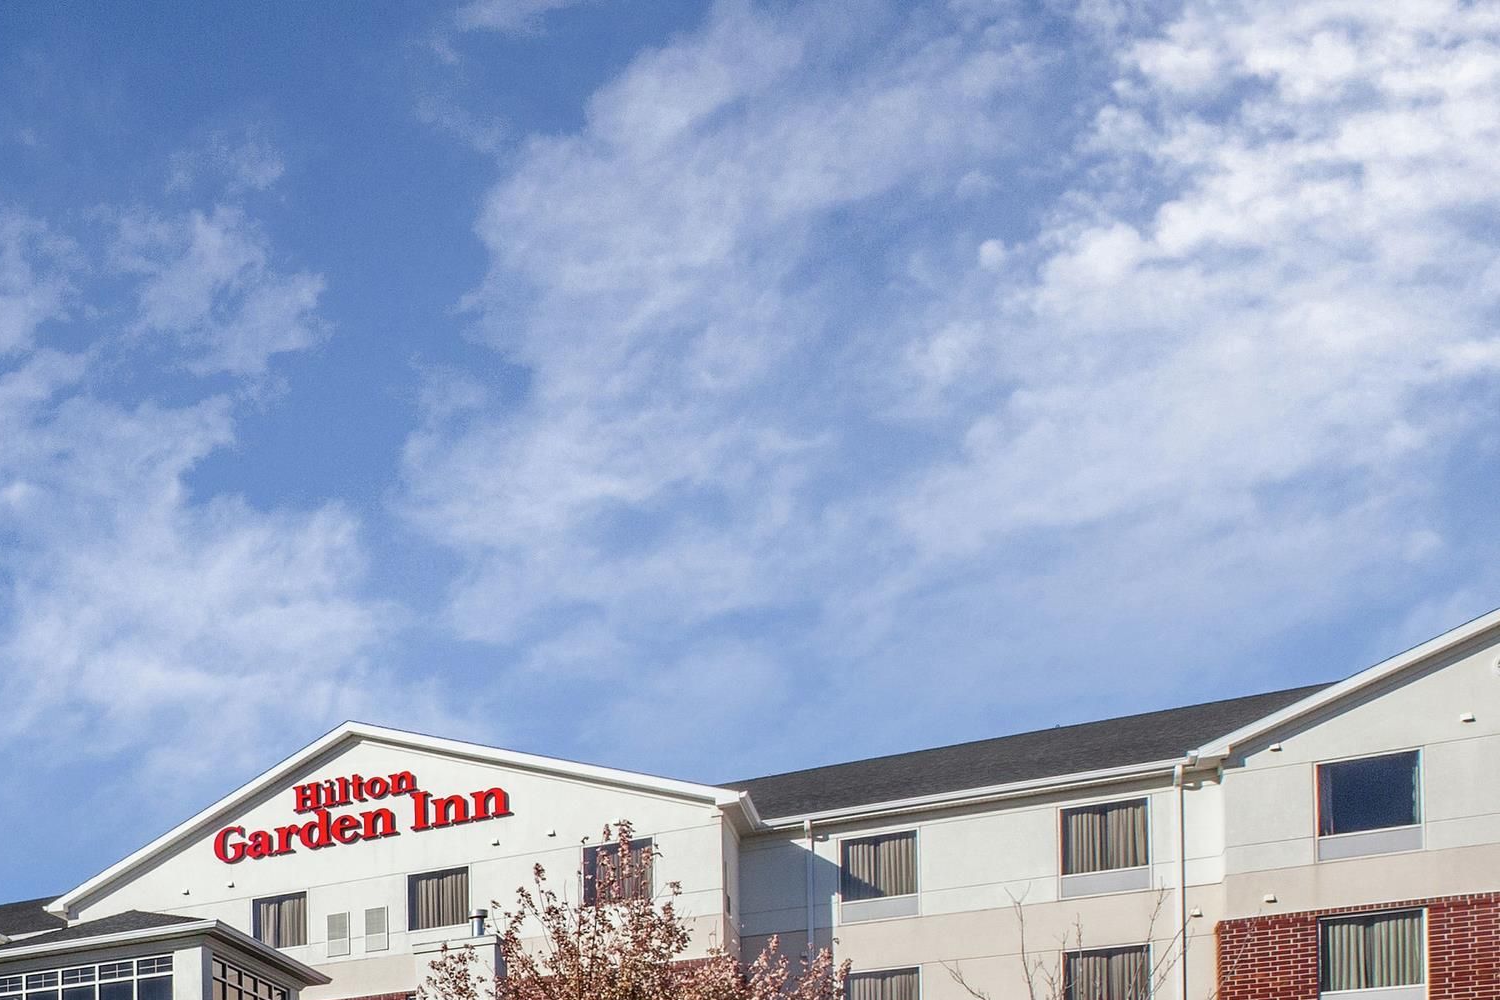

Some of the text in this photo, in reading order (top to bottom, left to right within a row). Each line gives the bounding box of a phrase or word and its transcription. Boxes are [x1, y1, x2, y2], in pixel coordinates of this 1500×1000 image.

[292, 770, 418, 813] Hilton
[213, 786, 514, 864] Garden Inn
